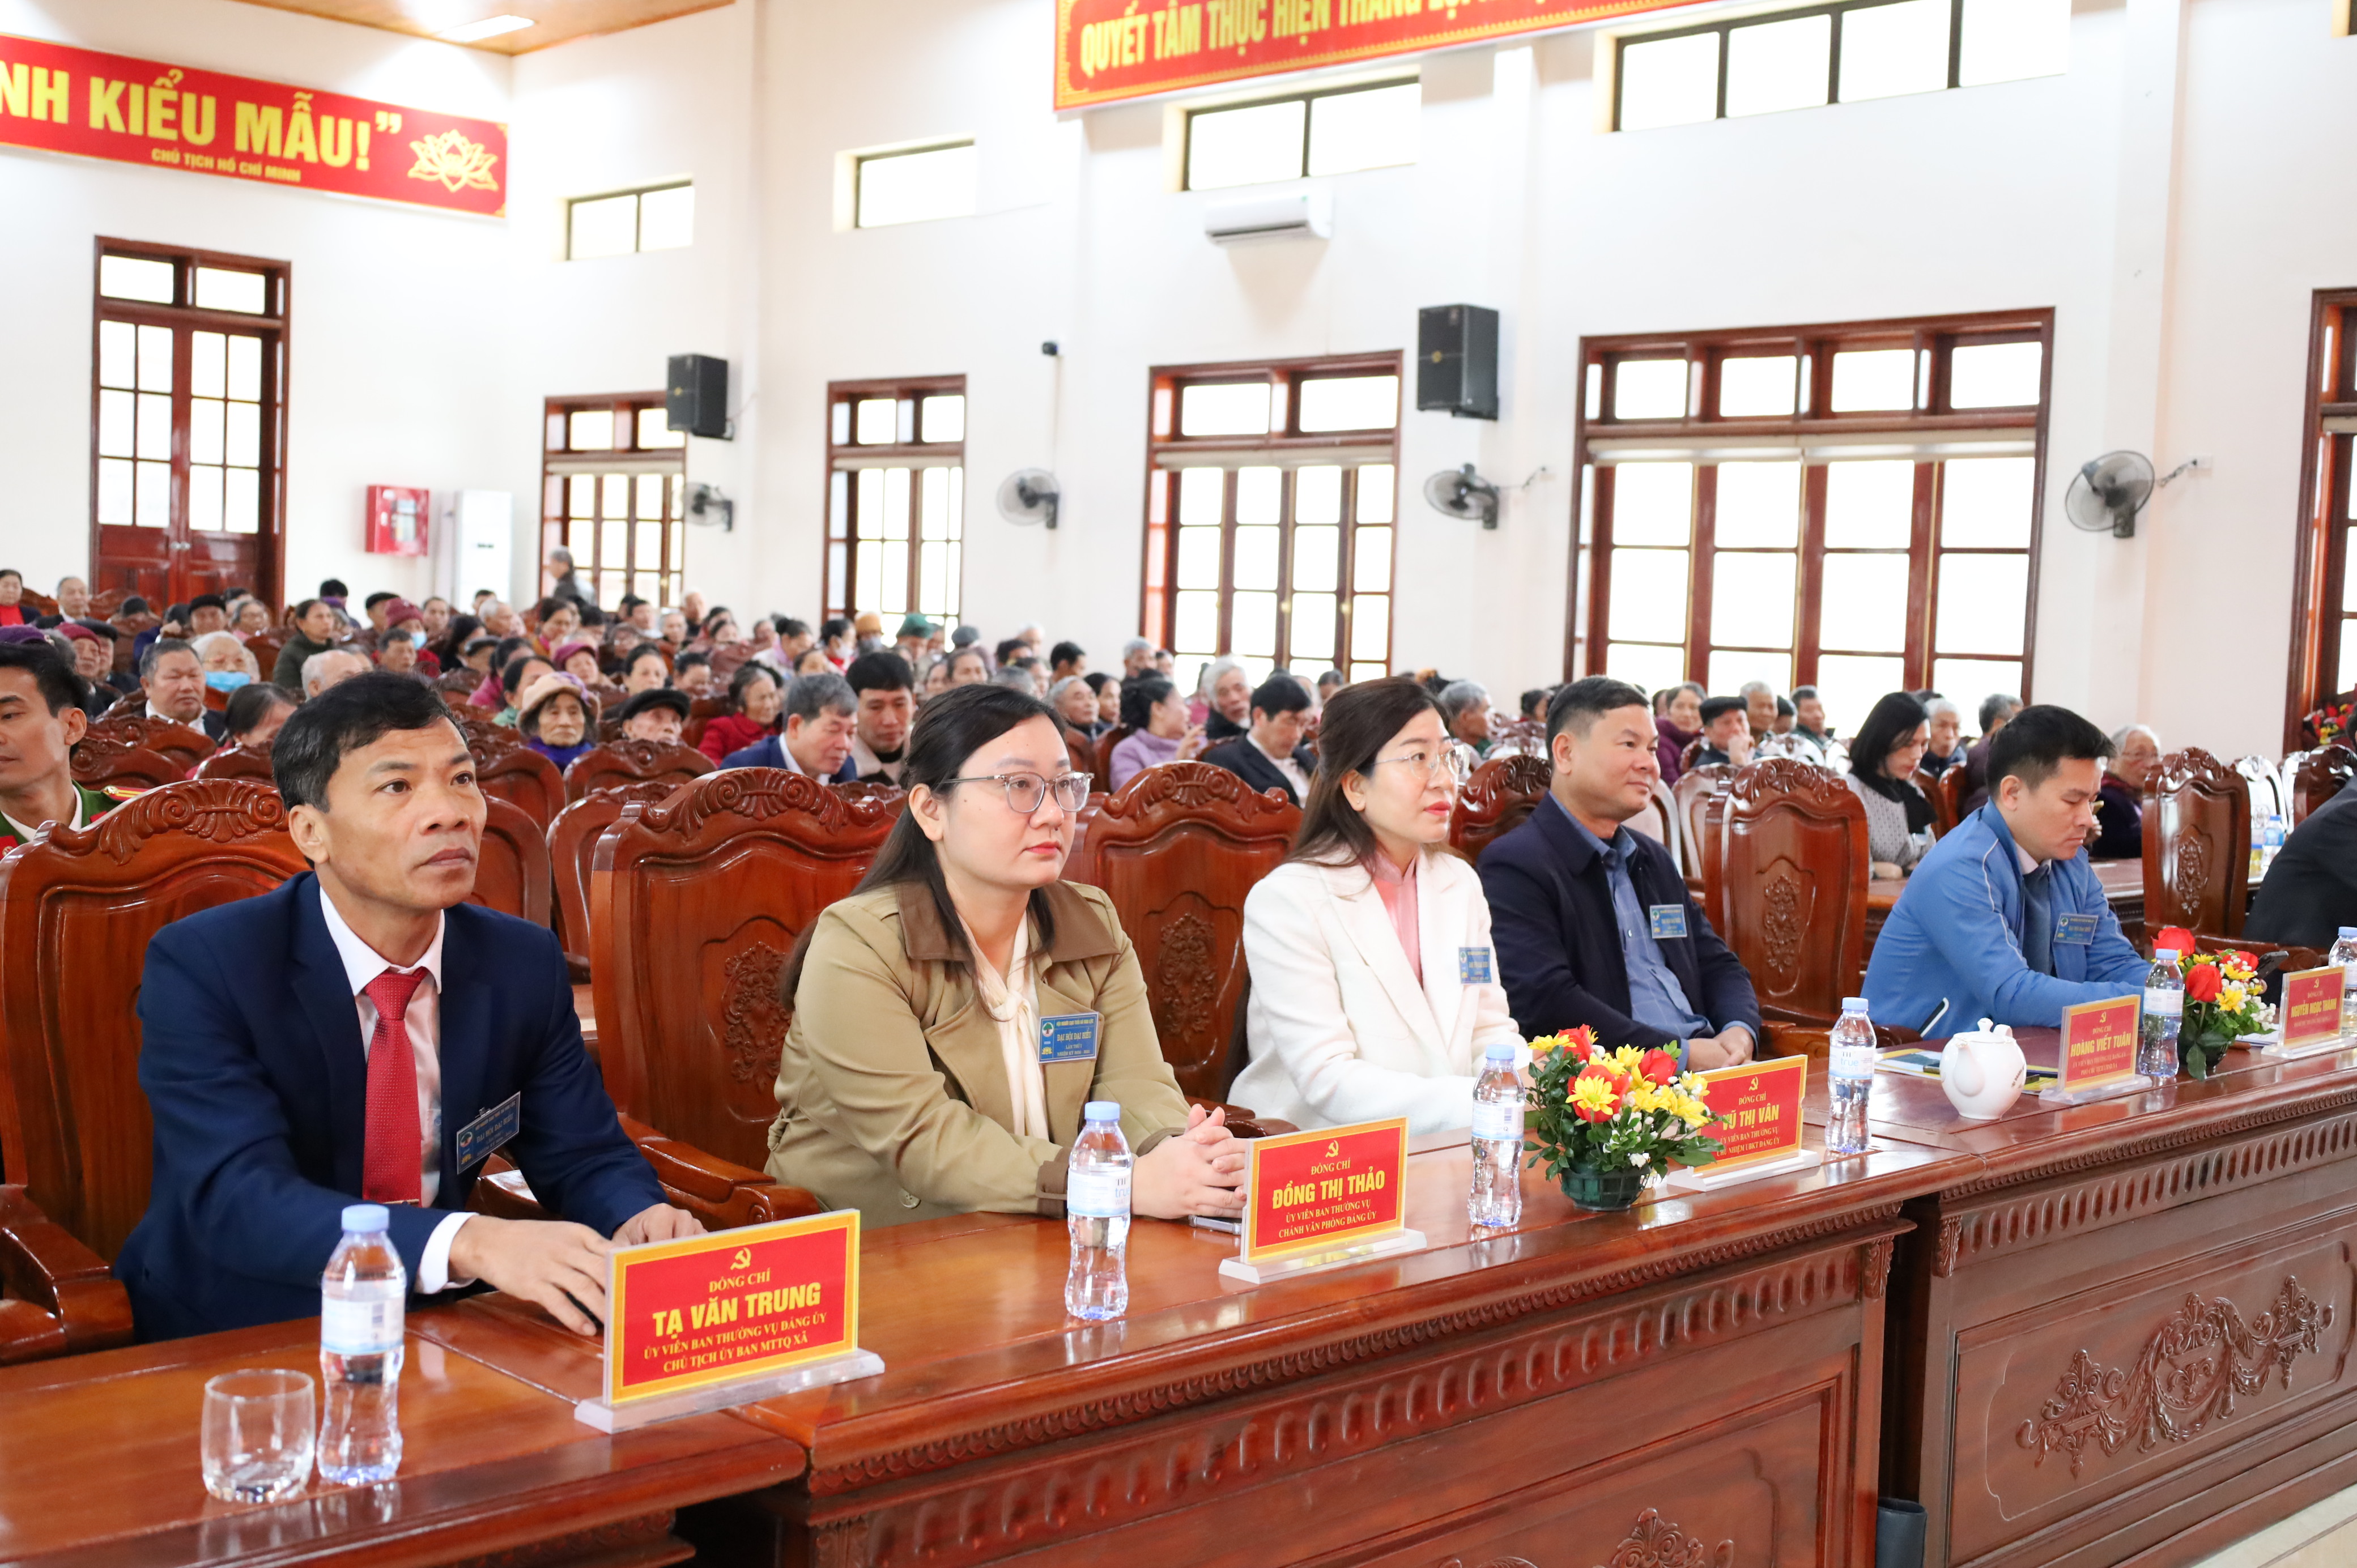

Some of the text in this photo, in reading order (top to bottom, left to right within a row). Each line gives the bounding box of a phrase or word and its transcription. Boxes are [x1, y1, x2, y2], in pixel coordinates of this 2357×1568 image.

[1080, 0, 1148, 78] QUYẾT
[90, 69, 216, 146] KIỂU
[151, 147, 301, 182] CHỦ TỊCH HỒ CHÍ MINH
[2070, 1039, 2095, 1058] HOÀNG
[2096, 1033, 2112, 1052] VIẾT
[1841, 1057, 1858, 1066] true
[1738, 1090, 1766, 1105] ĐỒNG CHÍ
[1739, 1109, 1756, 1128] THỊ
[1759, 1102, 1780, 1123] VÂN
[1740, 1132, 1750, 1141] BAN
[1311, 1157, 1351, 1175] ĐỒNG CHÍ
[1273, 1166, 1385, 1209] ĐỒNG THỊ THẢO
[1279, 1210, 1377, 1238] CHÁNH VĂN PHÒNG ĐẢNG ỦY
[1286, 1199, 1371, 1223] ỦY VIÊN BAN THƯỜNG VỤ
[747, 1267, 771, 1285] CHÍ
[652, 1282, 821, 1339] TẠ VĂN TRUNG
[662, 1339, 689, 1355] VIÊN
[691, 1335, 714, 1350] BAN
[716, 1325, 762, 1345] THƯỜNG
[764, 1322, 778, 1336] VỤ
[781, 1316, 810, 1332] ĐẢNG
[663, 1356, 688, 1373] CHỦ
[690, 1352, 717, 1369] TỊCH
[737, 1343, 758, 1357] BAN
[761, 1336, 792, 1352] MTTQ
[793, 1331, 808, 1345] XÃ
